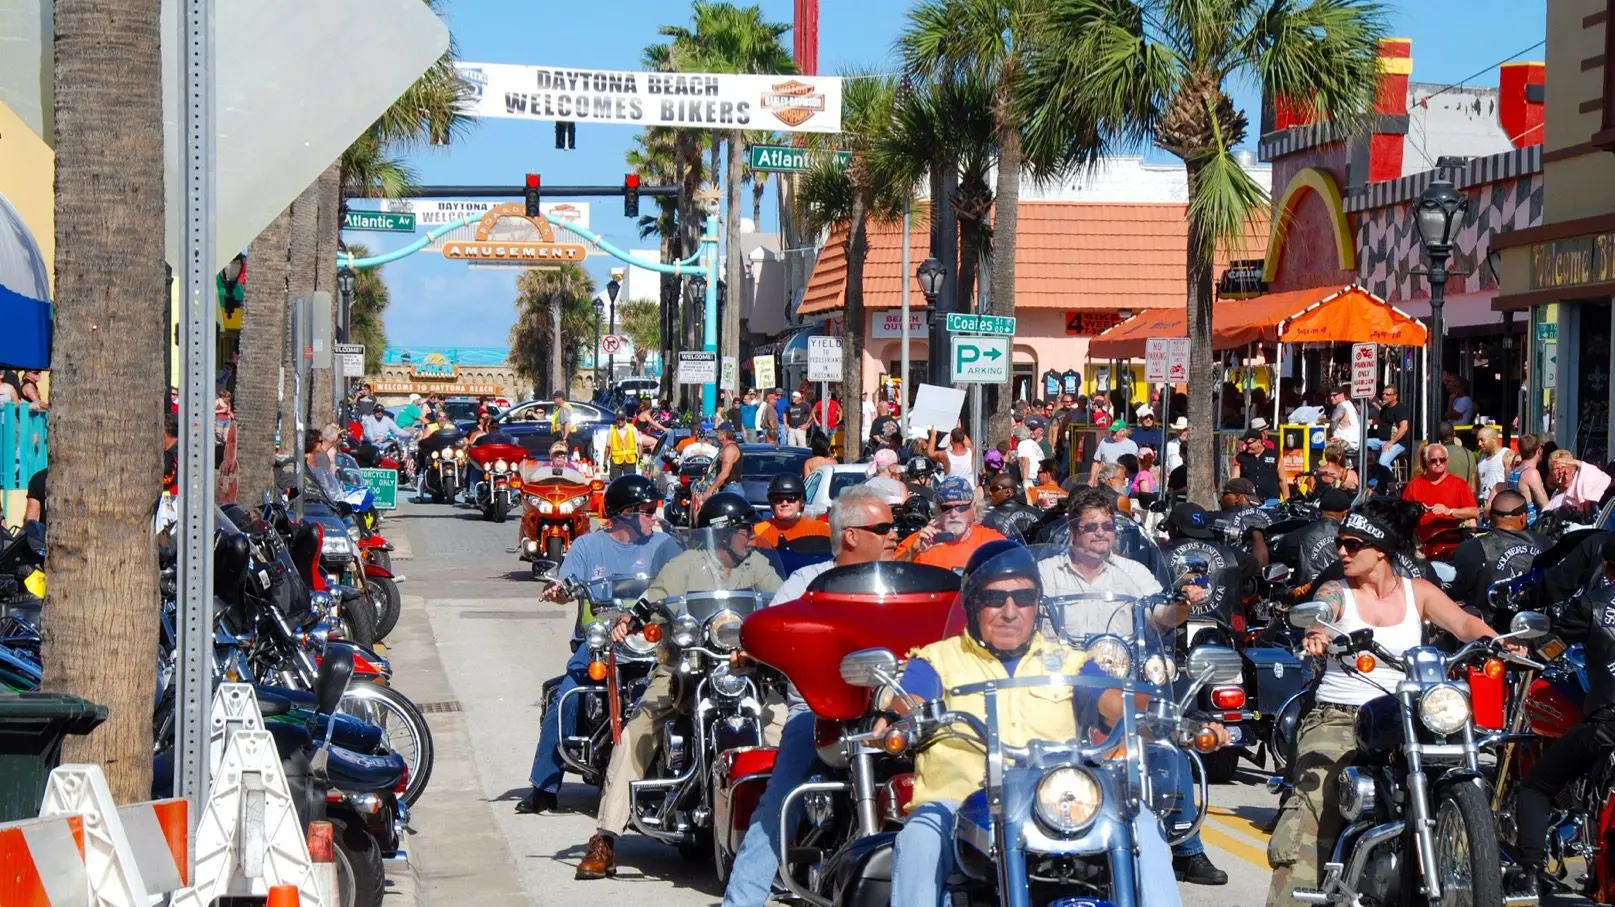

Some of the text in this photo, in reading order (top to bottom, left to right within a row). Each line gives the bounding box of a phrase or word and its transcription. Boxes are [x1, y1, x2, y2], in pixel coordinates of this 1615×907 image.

[537, 70, 719, 97] DAYTONA BEACH
[504, 92, 750, 125] WELCOMES BIKERS
[758, 150, 812, 168] Atlant
[438, 203, 488, 211] DAYTONA
[345, 214, 410, 228] Atlantic Av
[450, 246, 576, 259] AMUSEMENT
[884, 323, 922, 331] OUTET
[954, 317, 993, 332] Coates
[1067, 311, 1084, 334] 4
[811, 339, 842, 348] YIELD
[1153, 343, 1161, 351] NO
[1354, 361, 1374, 369] PARKING
[1358, 370, 1369, 378] ONLY
[377, 384, 413, 392] WELCOME
[417, 384, 427, 392] TO
[430, 384, 466, 393] DAYTONA
[379, 479, 395, 487] ONLY
[1170, 542, 1226, 568] SOLDIERS UNITED
[1497, 545, 1528, 571] SOLDIERS
